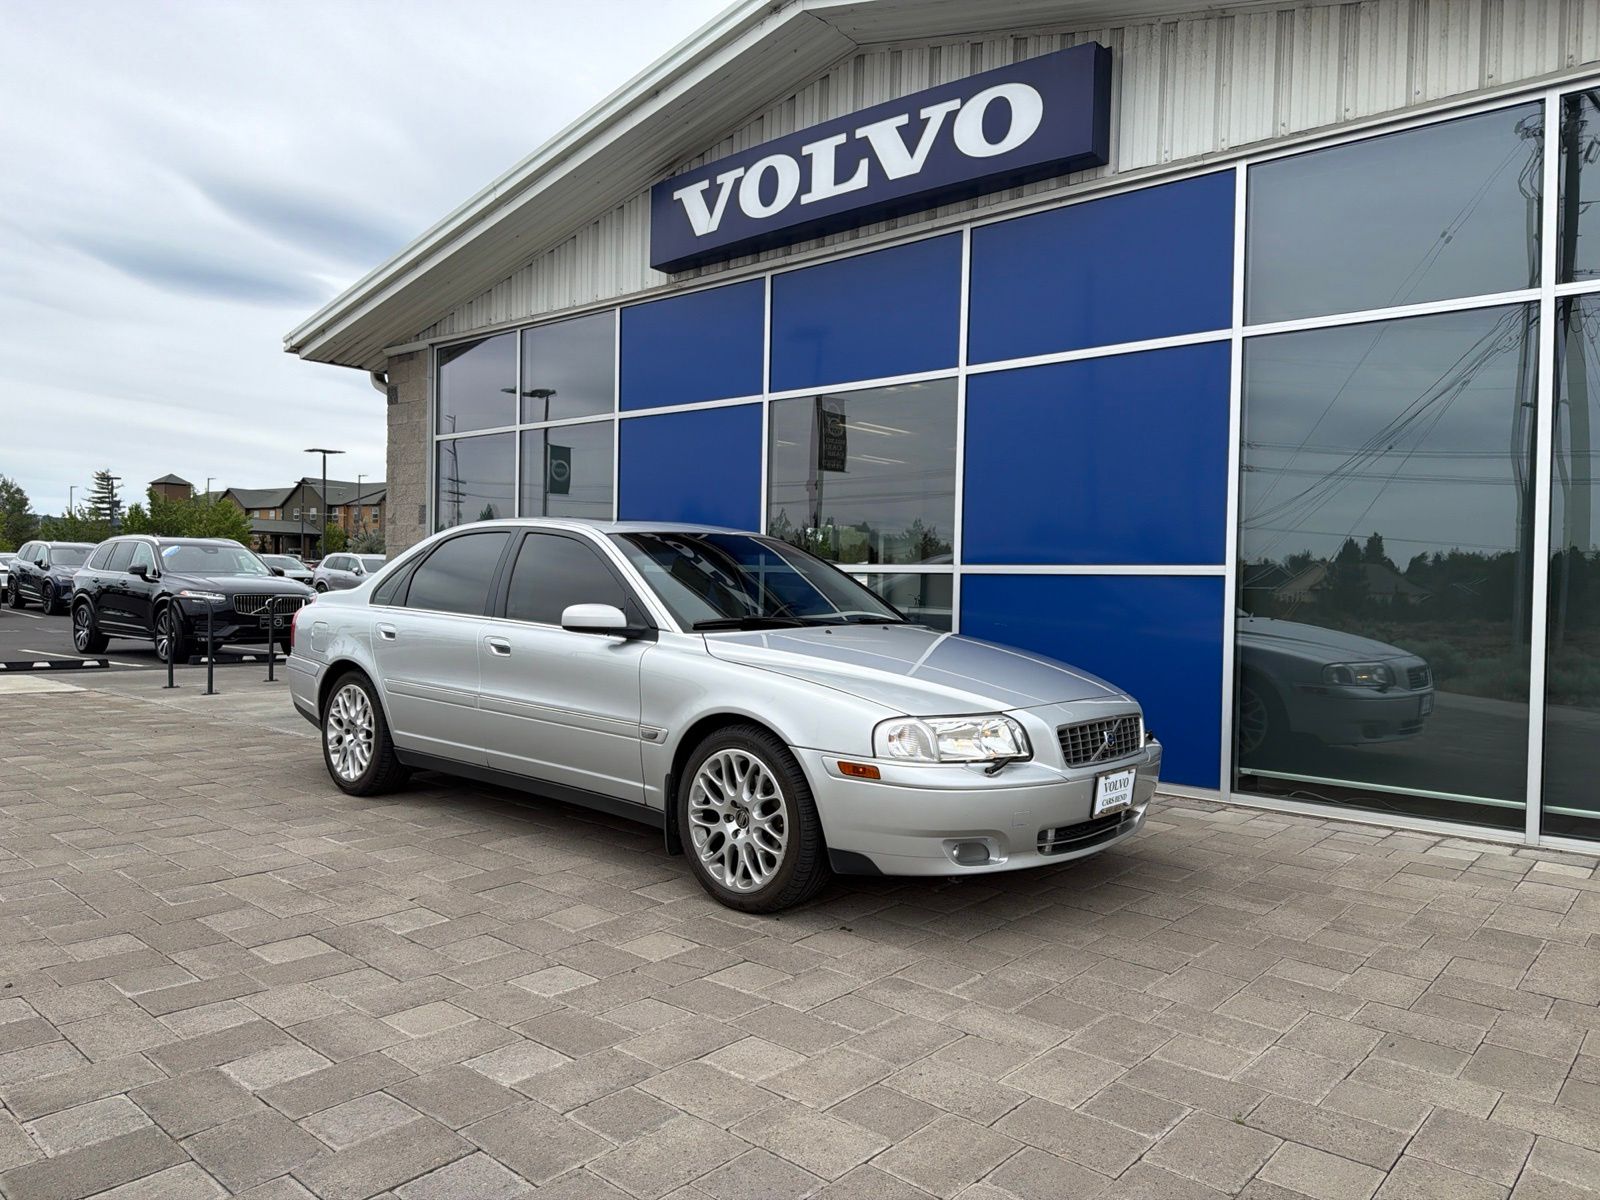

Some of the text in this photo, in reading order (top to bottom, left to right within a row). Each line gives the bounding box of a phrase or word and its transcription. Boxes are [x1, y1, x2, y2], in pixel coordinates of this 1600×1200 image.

[673, 83, 1044, 237] VOLVO
[1104, 777, 1129, 793] VOLVO
[1101, 793, 1127, 806] CARS BEND
